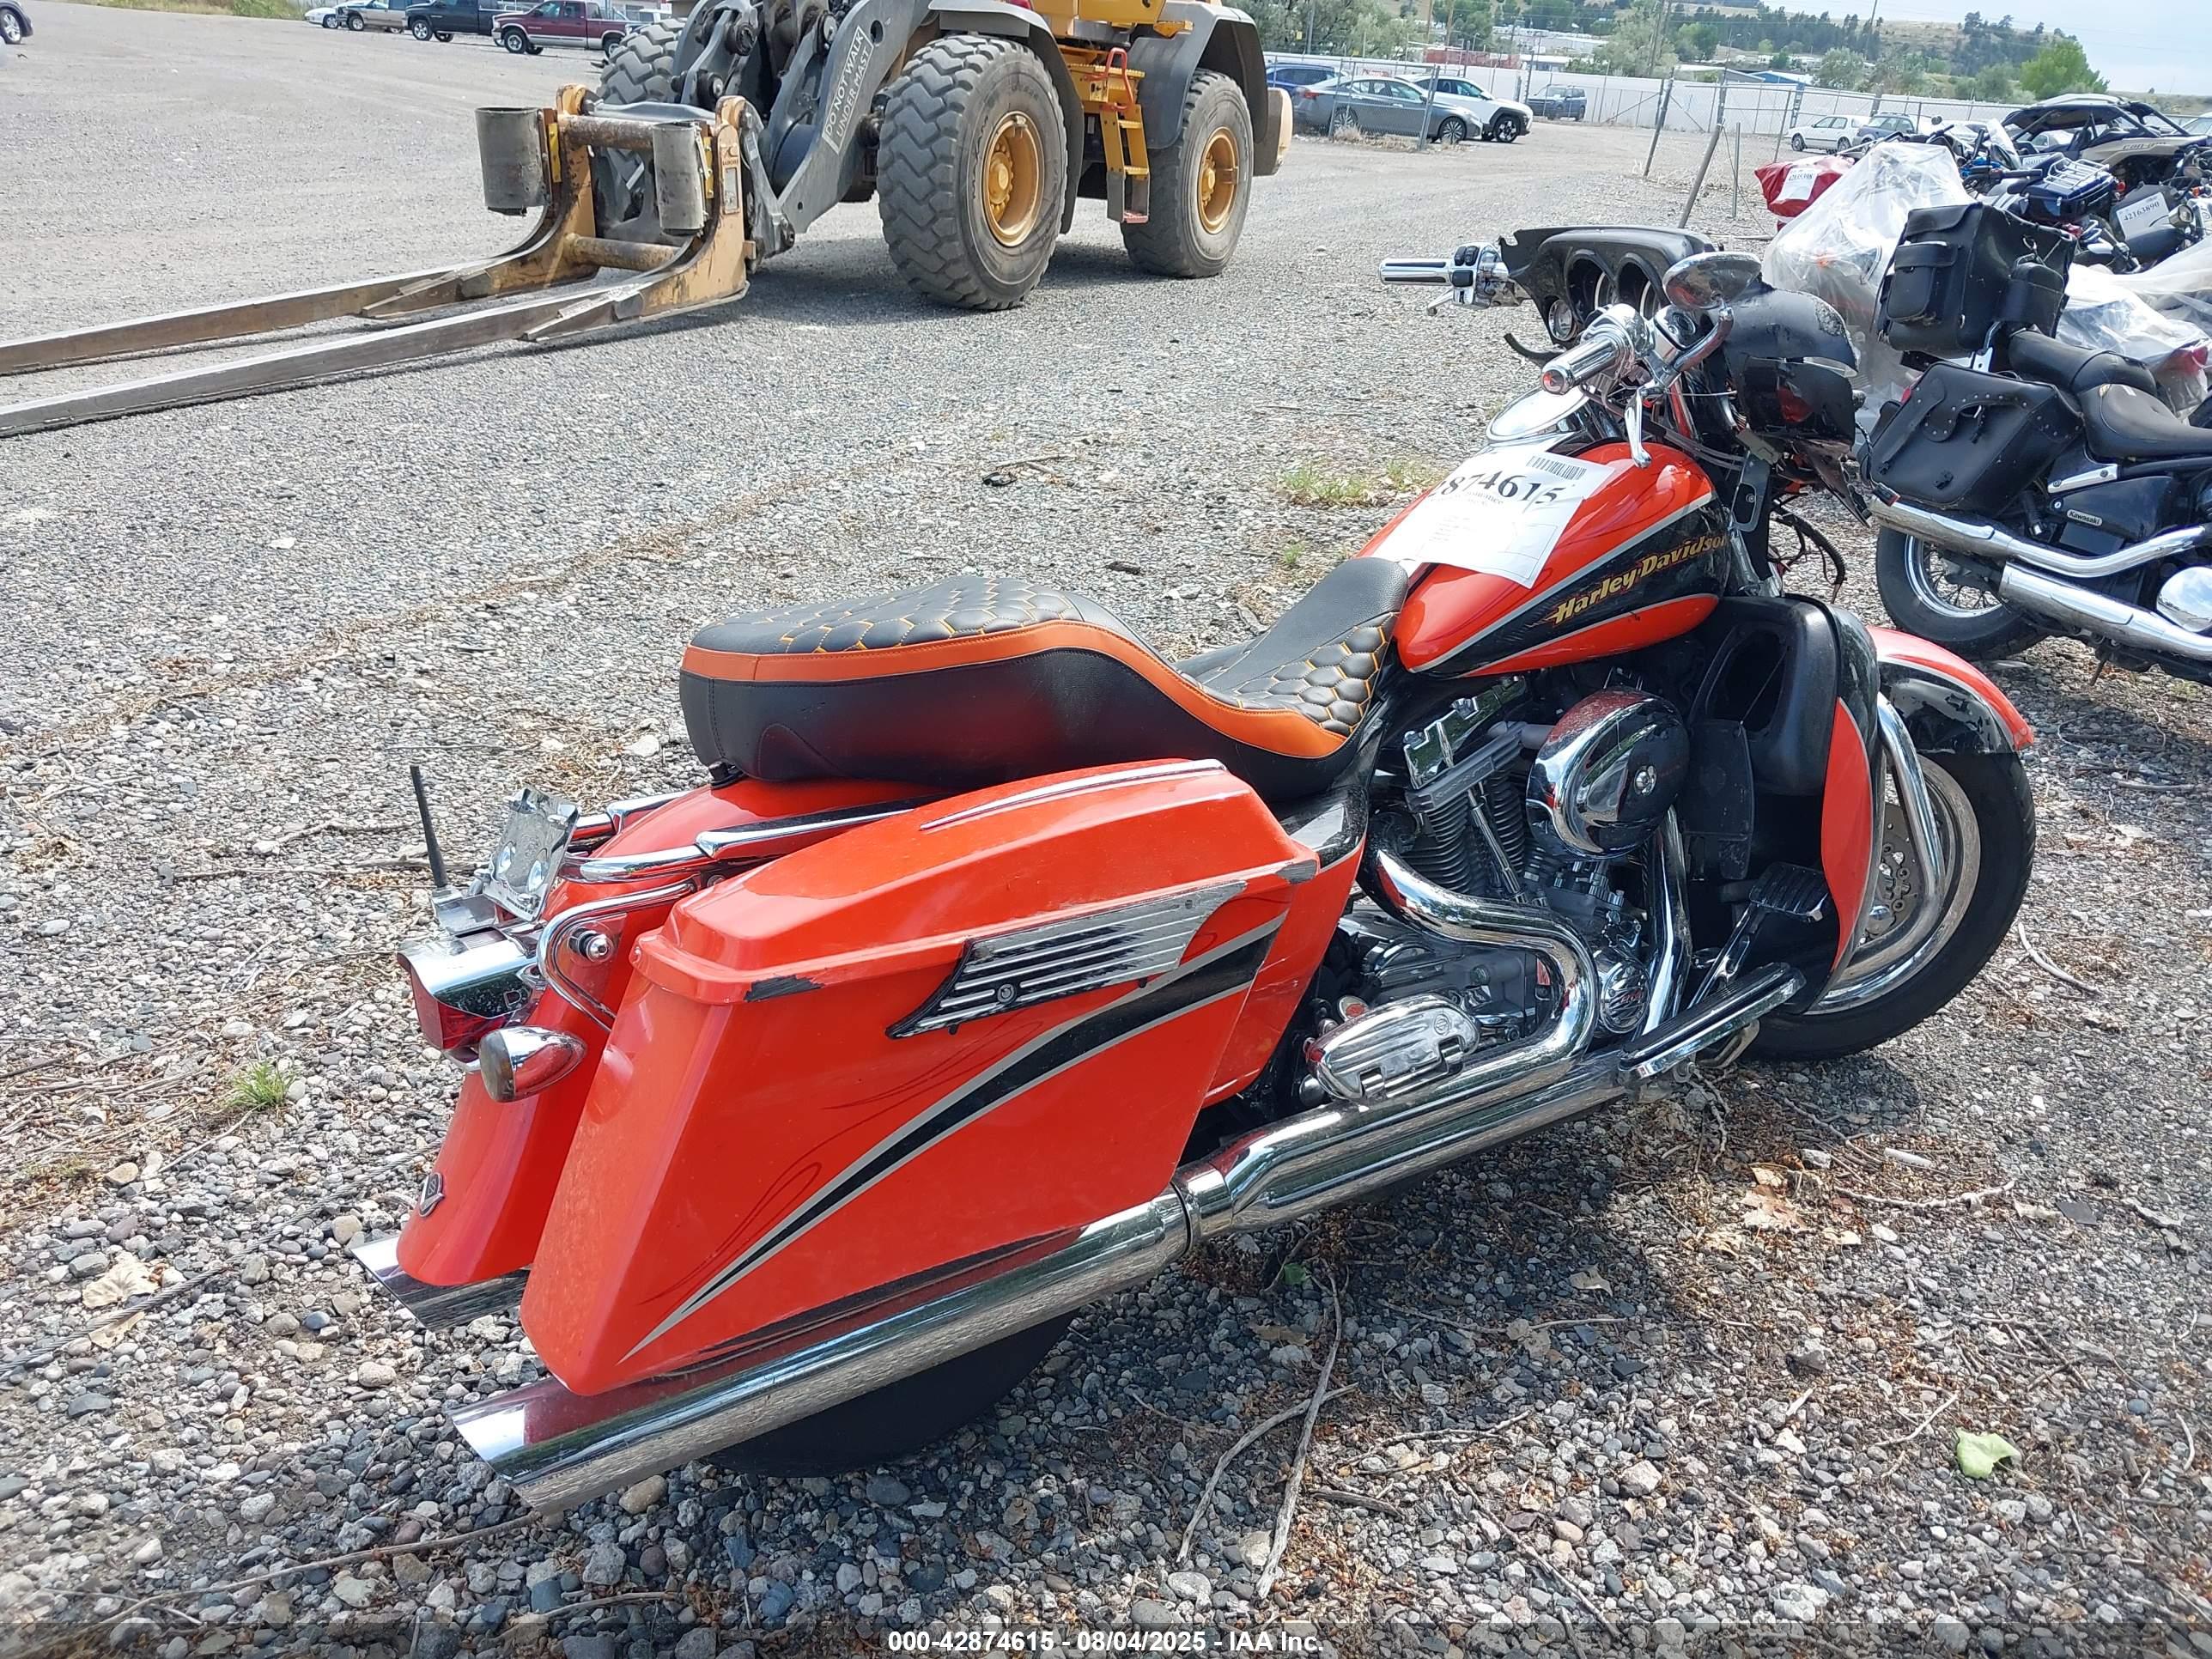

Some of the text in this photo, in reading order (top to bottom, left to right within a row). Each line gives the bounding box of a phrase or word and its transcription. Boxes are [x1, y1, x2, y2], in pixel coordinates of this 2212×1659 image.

[825, 32, 865, 136] DO NOT WALK
[836, 46, 870, 137] UNDER MAST
[2124, 201, 2160, 221] 42163890
[2069, 510, 2100, 525] Kawasaki
